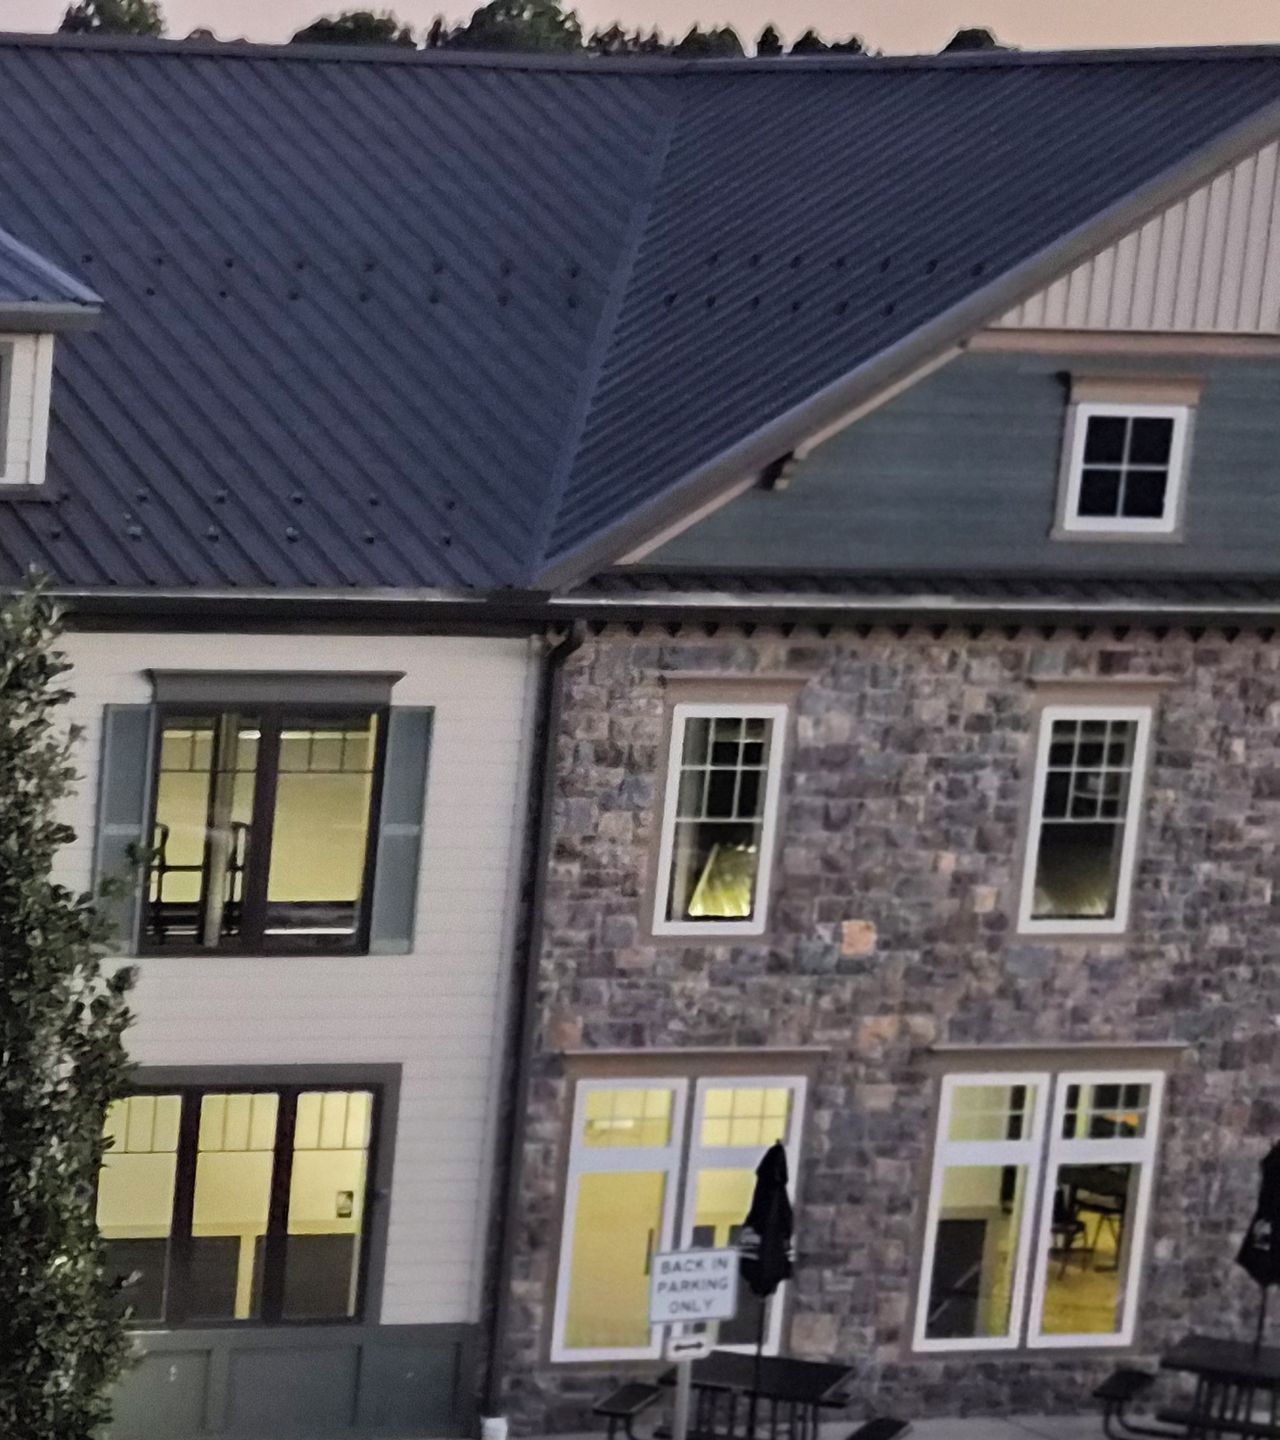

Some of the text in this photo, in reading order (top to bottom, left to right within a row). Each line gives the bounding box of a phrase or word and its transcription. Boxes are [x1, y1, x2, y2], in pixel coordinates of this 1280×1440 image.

[661, 1258, 728, 1275] BACK IN
[657, 1278, 728, 1294] PARKING
[668, 1299, 713, 1314] ONLY
